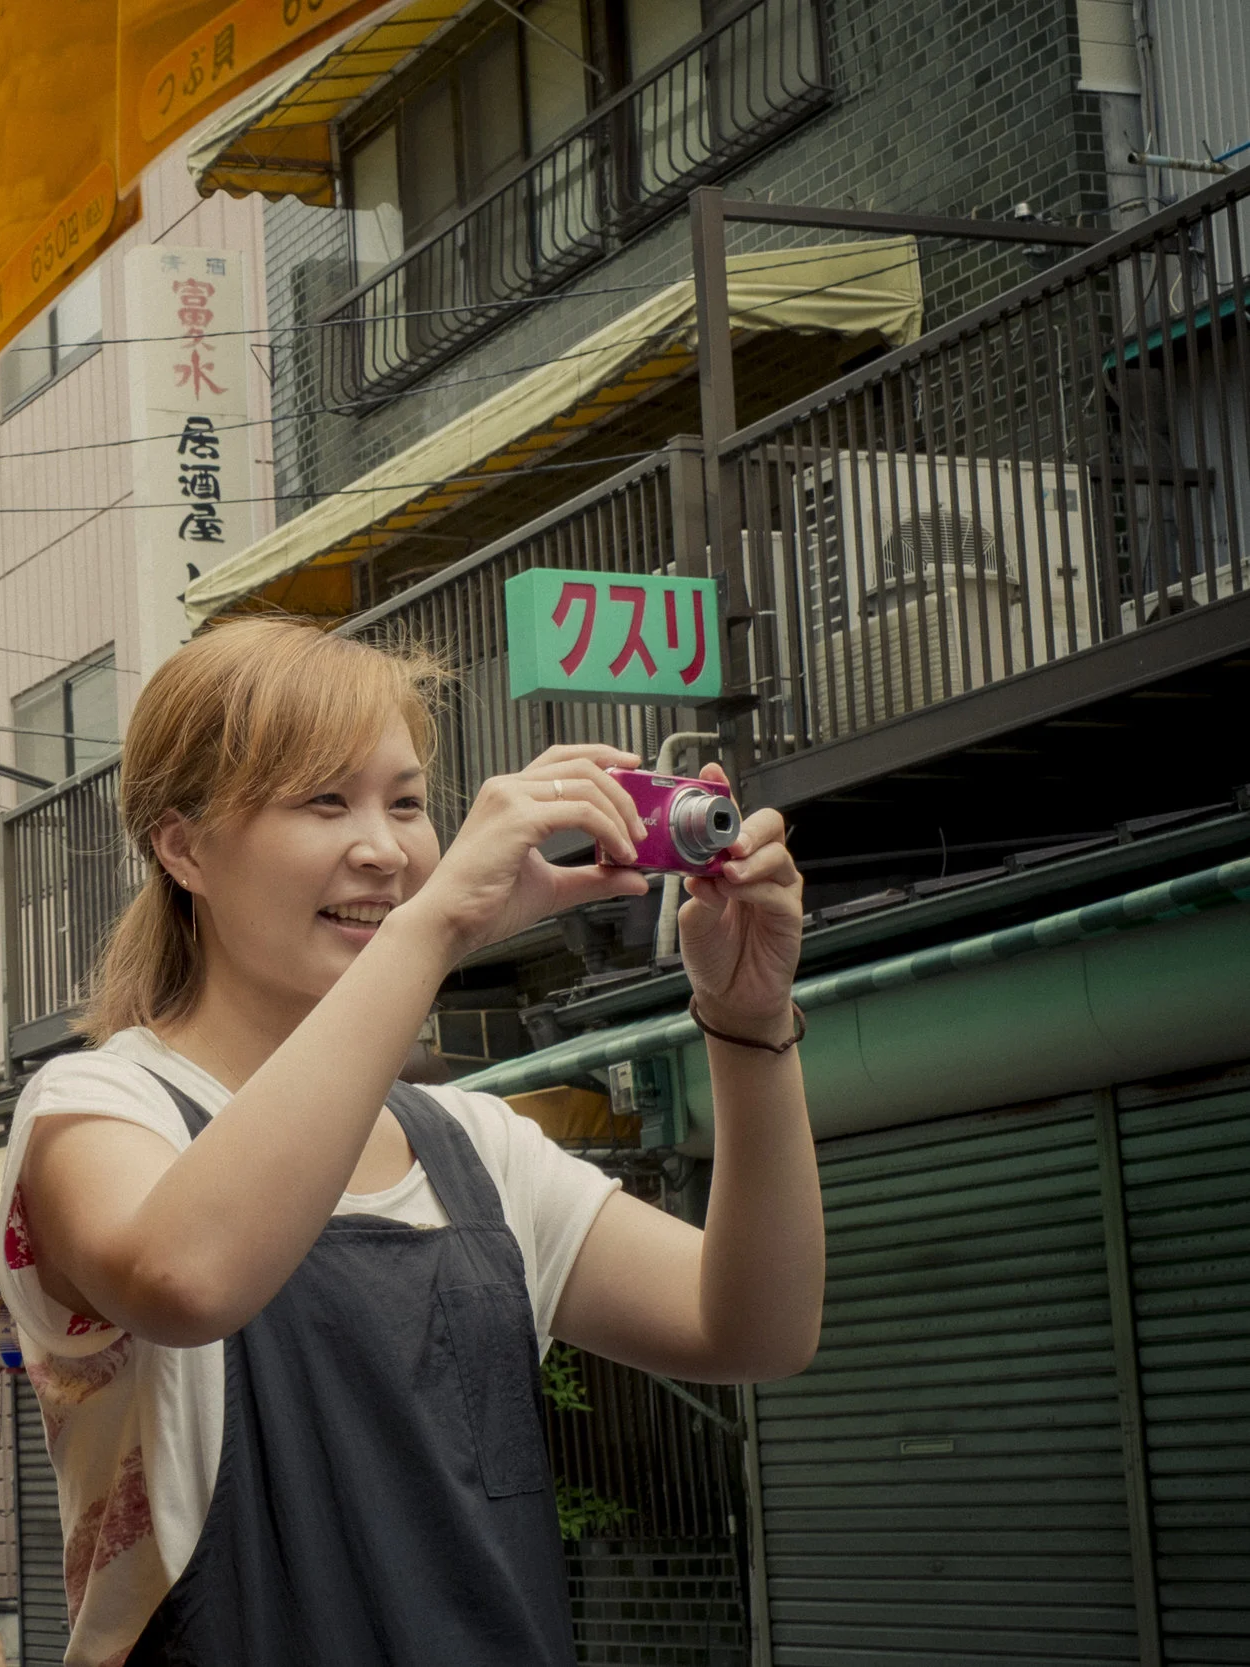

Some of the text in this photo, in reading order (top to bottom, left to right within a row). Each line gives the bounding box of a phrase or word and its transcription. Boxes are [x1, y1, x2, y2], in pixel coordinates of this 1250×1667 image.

[157, 22, 236, 116] つぶ貝
[177, 416, 226, 544] 居酒屋
[551, 582, 707, 687] クスリ
[640, 815, 658, 827] MIX
